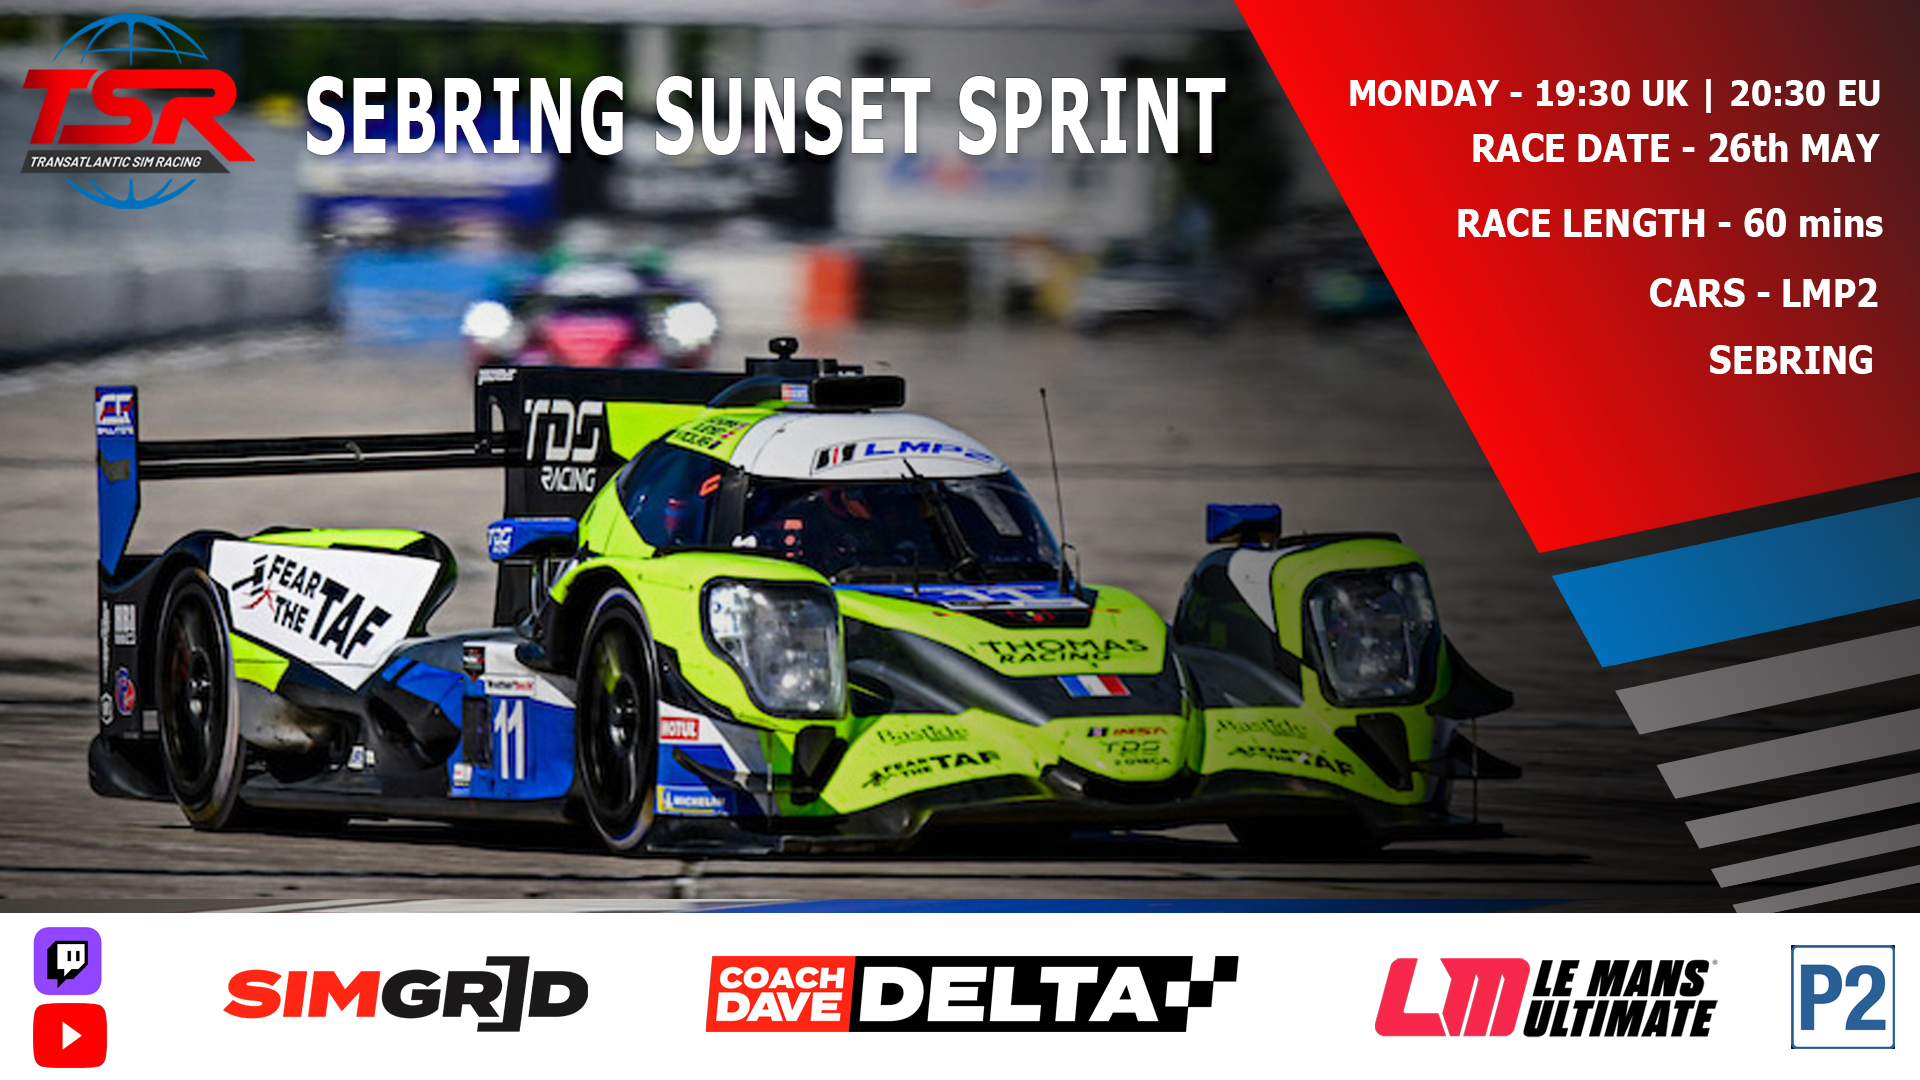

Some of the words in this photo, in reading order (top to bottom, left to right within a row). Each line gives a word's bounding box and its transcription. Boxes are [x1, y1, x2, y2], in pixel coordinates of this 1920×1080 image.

[524, 399, 603, 462] TDS
[865, 441, 995, 463] LMP2
[541, 465, 597, 492] RACING
[267, 555, 322, 598] FEAR
[274, 595, 310, 634] THE
[309, 577, 392, 659] TAF
[979, 639, 1148, 654] THOMAS
[1000, 652, 1111, 664] RACING
[494, 699, 525, 780] 11
[661, 719, 697, 738] MOTUL
